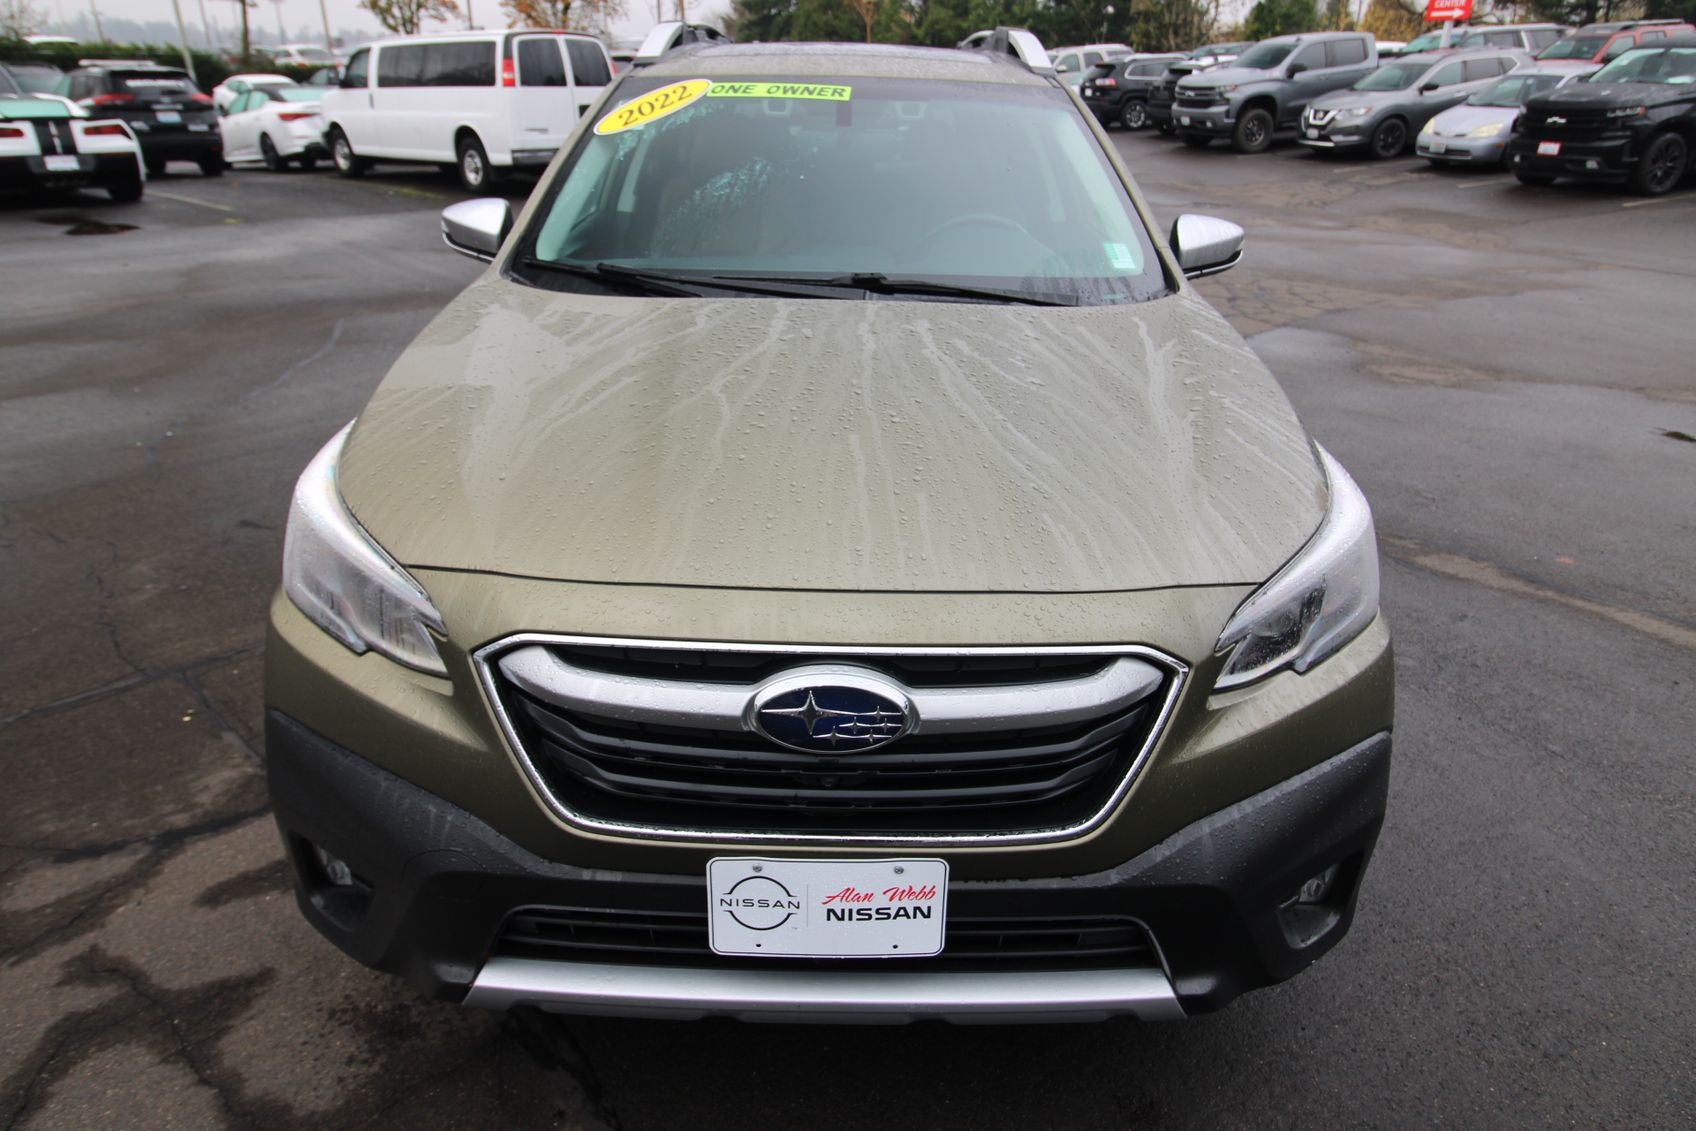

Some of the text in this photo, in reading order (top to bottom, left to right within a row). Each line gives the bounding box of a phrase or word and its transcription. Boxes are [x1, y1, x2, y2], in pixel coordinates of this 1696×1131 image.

[711, 84, 848, 98] ONE OWNER
[617, 84, 693, 128] 2022
[821, 885, 937, 905] Alan Webb
[720, 898, 801, 910] NISSAN
[826, 905, 932, 922] NISSAN
